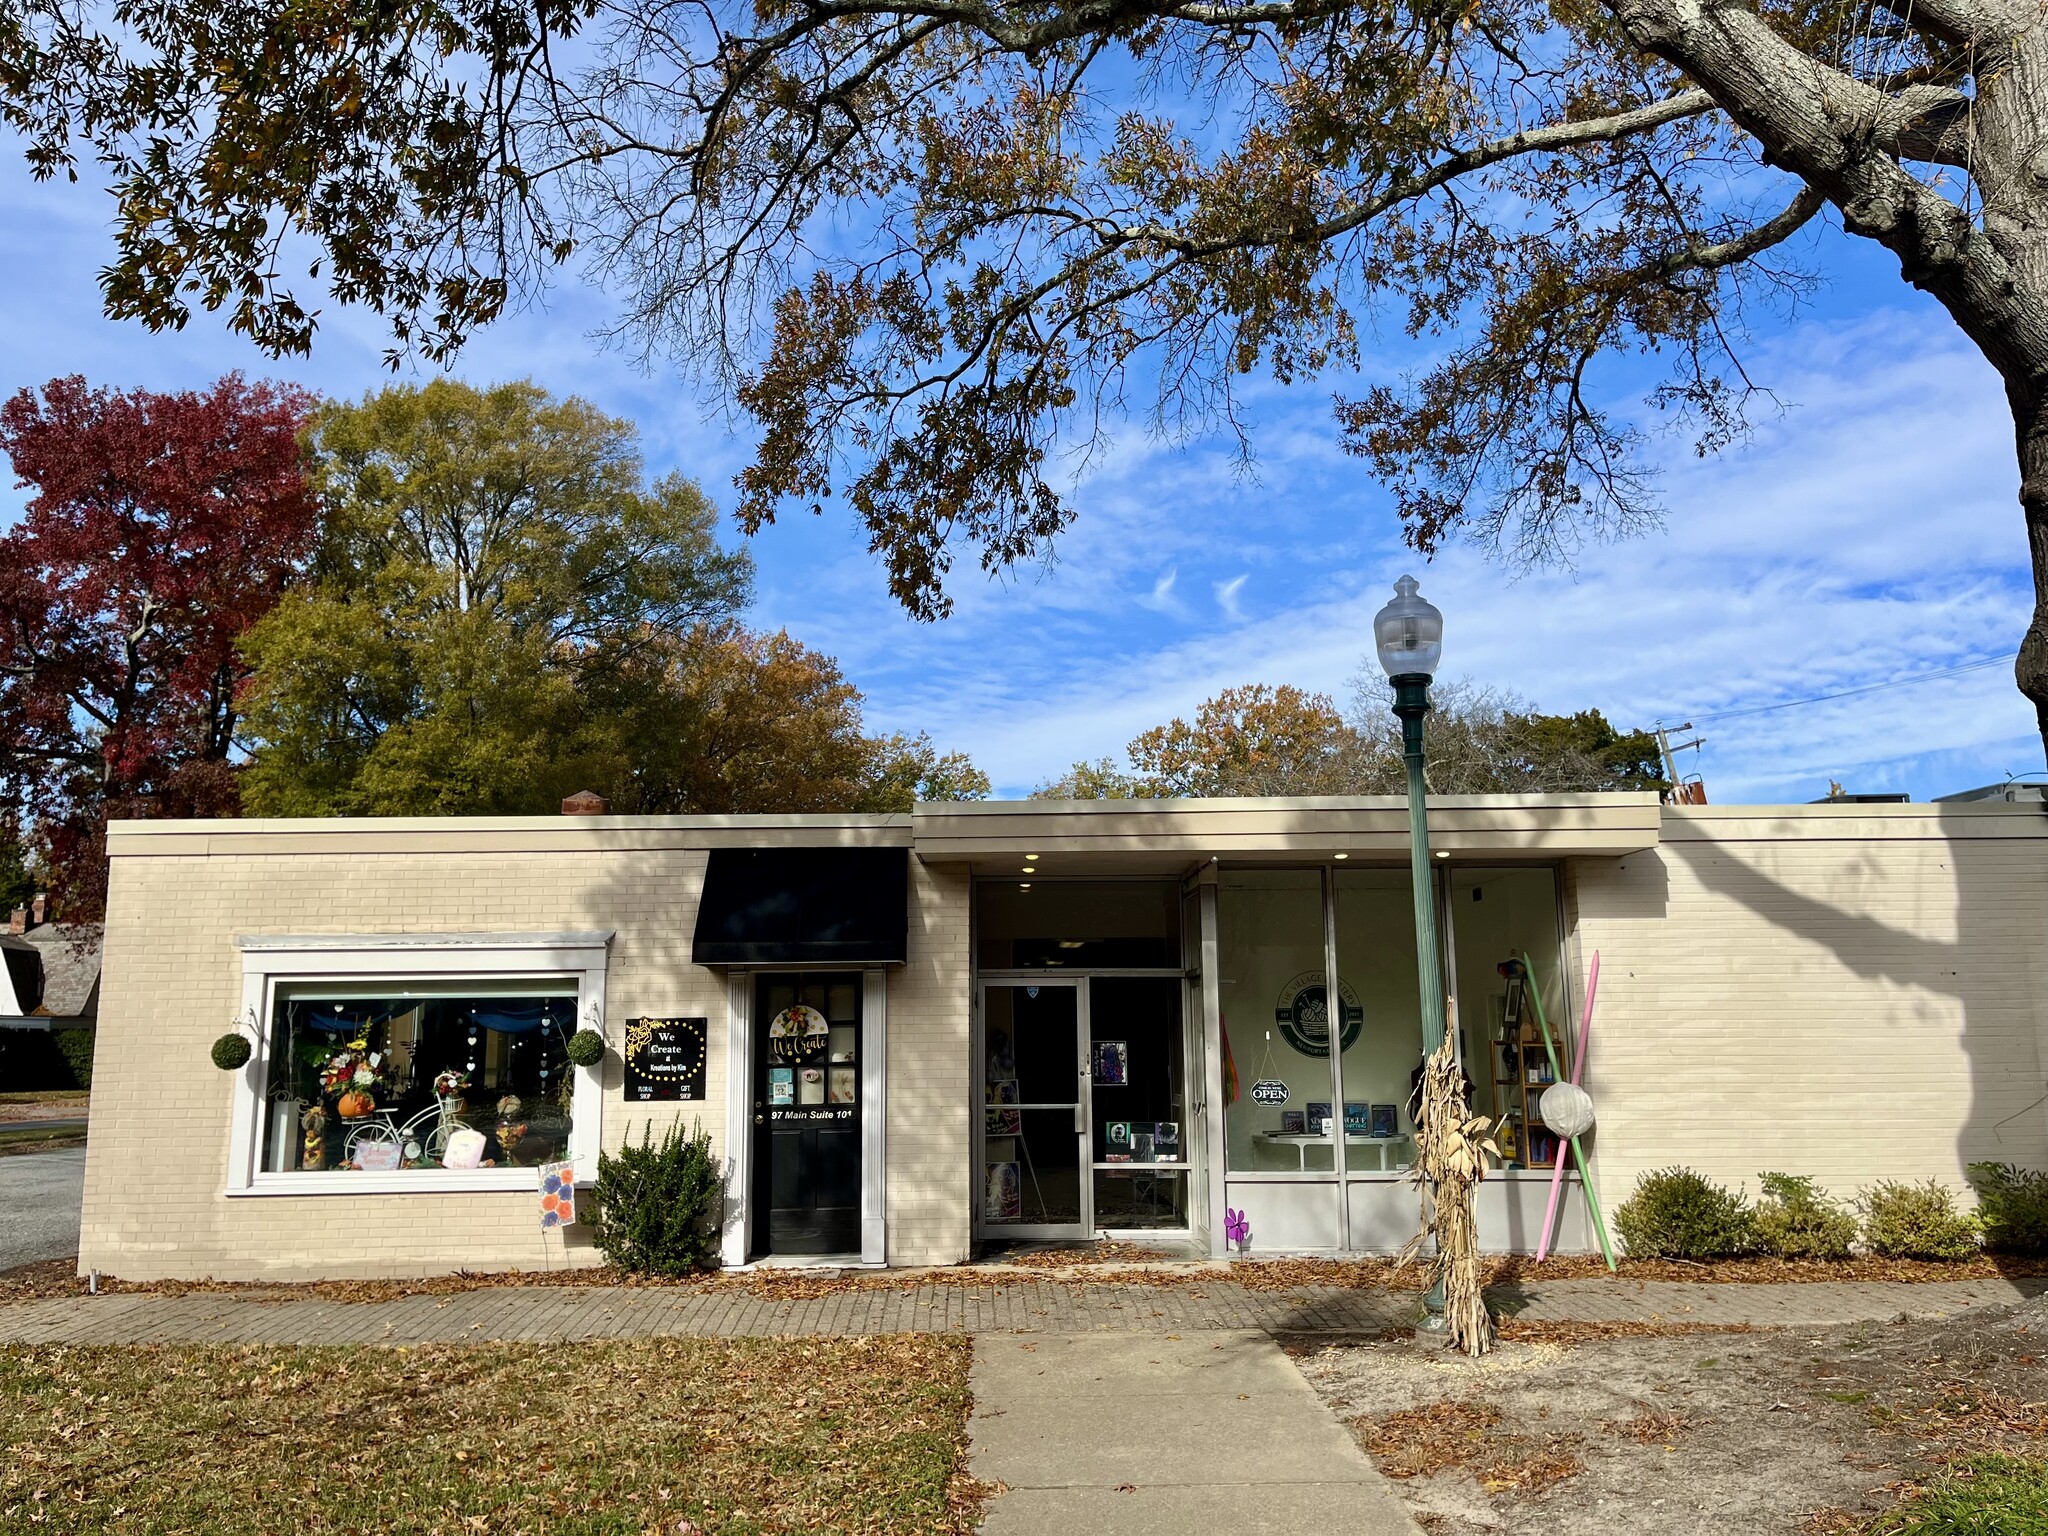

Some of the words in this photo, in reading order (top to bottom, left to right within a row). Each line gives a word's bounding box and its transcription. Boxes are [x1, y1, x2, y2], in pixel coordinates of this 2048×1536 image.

[1282, 992, 1292, 1005] THE
[1291, 974, 1322, 991] VILLAGE
[658, 1032, 675, 1041] We
[650, 1045, 682, 1053] Create
[774, 1038, 792, 1055] We
[794, 1034, 827, 1054] Create
[1295, 1040, 1322, 1055] NEWPORT
[671, 1064, 677, 1073] by
[677, 1063, 687, 1071] Kim
[1252, 1089, 1288, 1099] OPEN
[771, 1111, 783, 1120] 97
[784, 1111, 807, 1119] Main
[809, 1110, 834, 1119] Suite
[836, 1109, 852, 1119] 101
